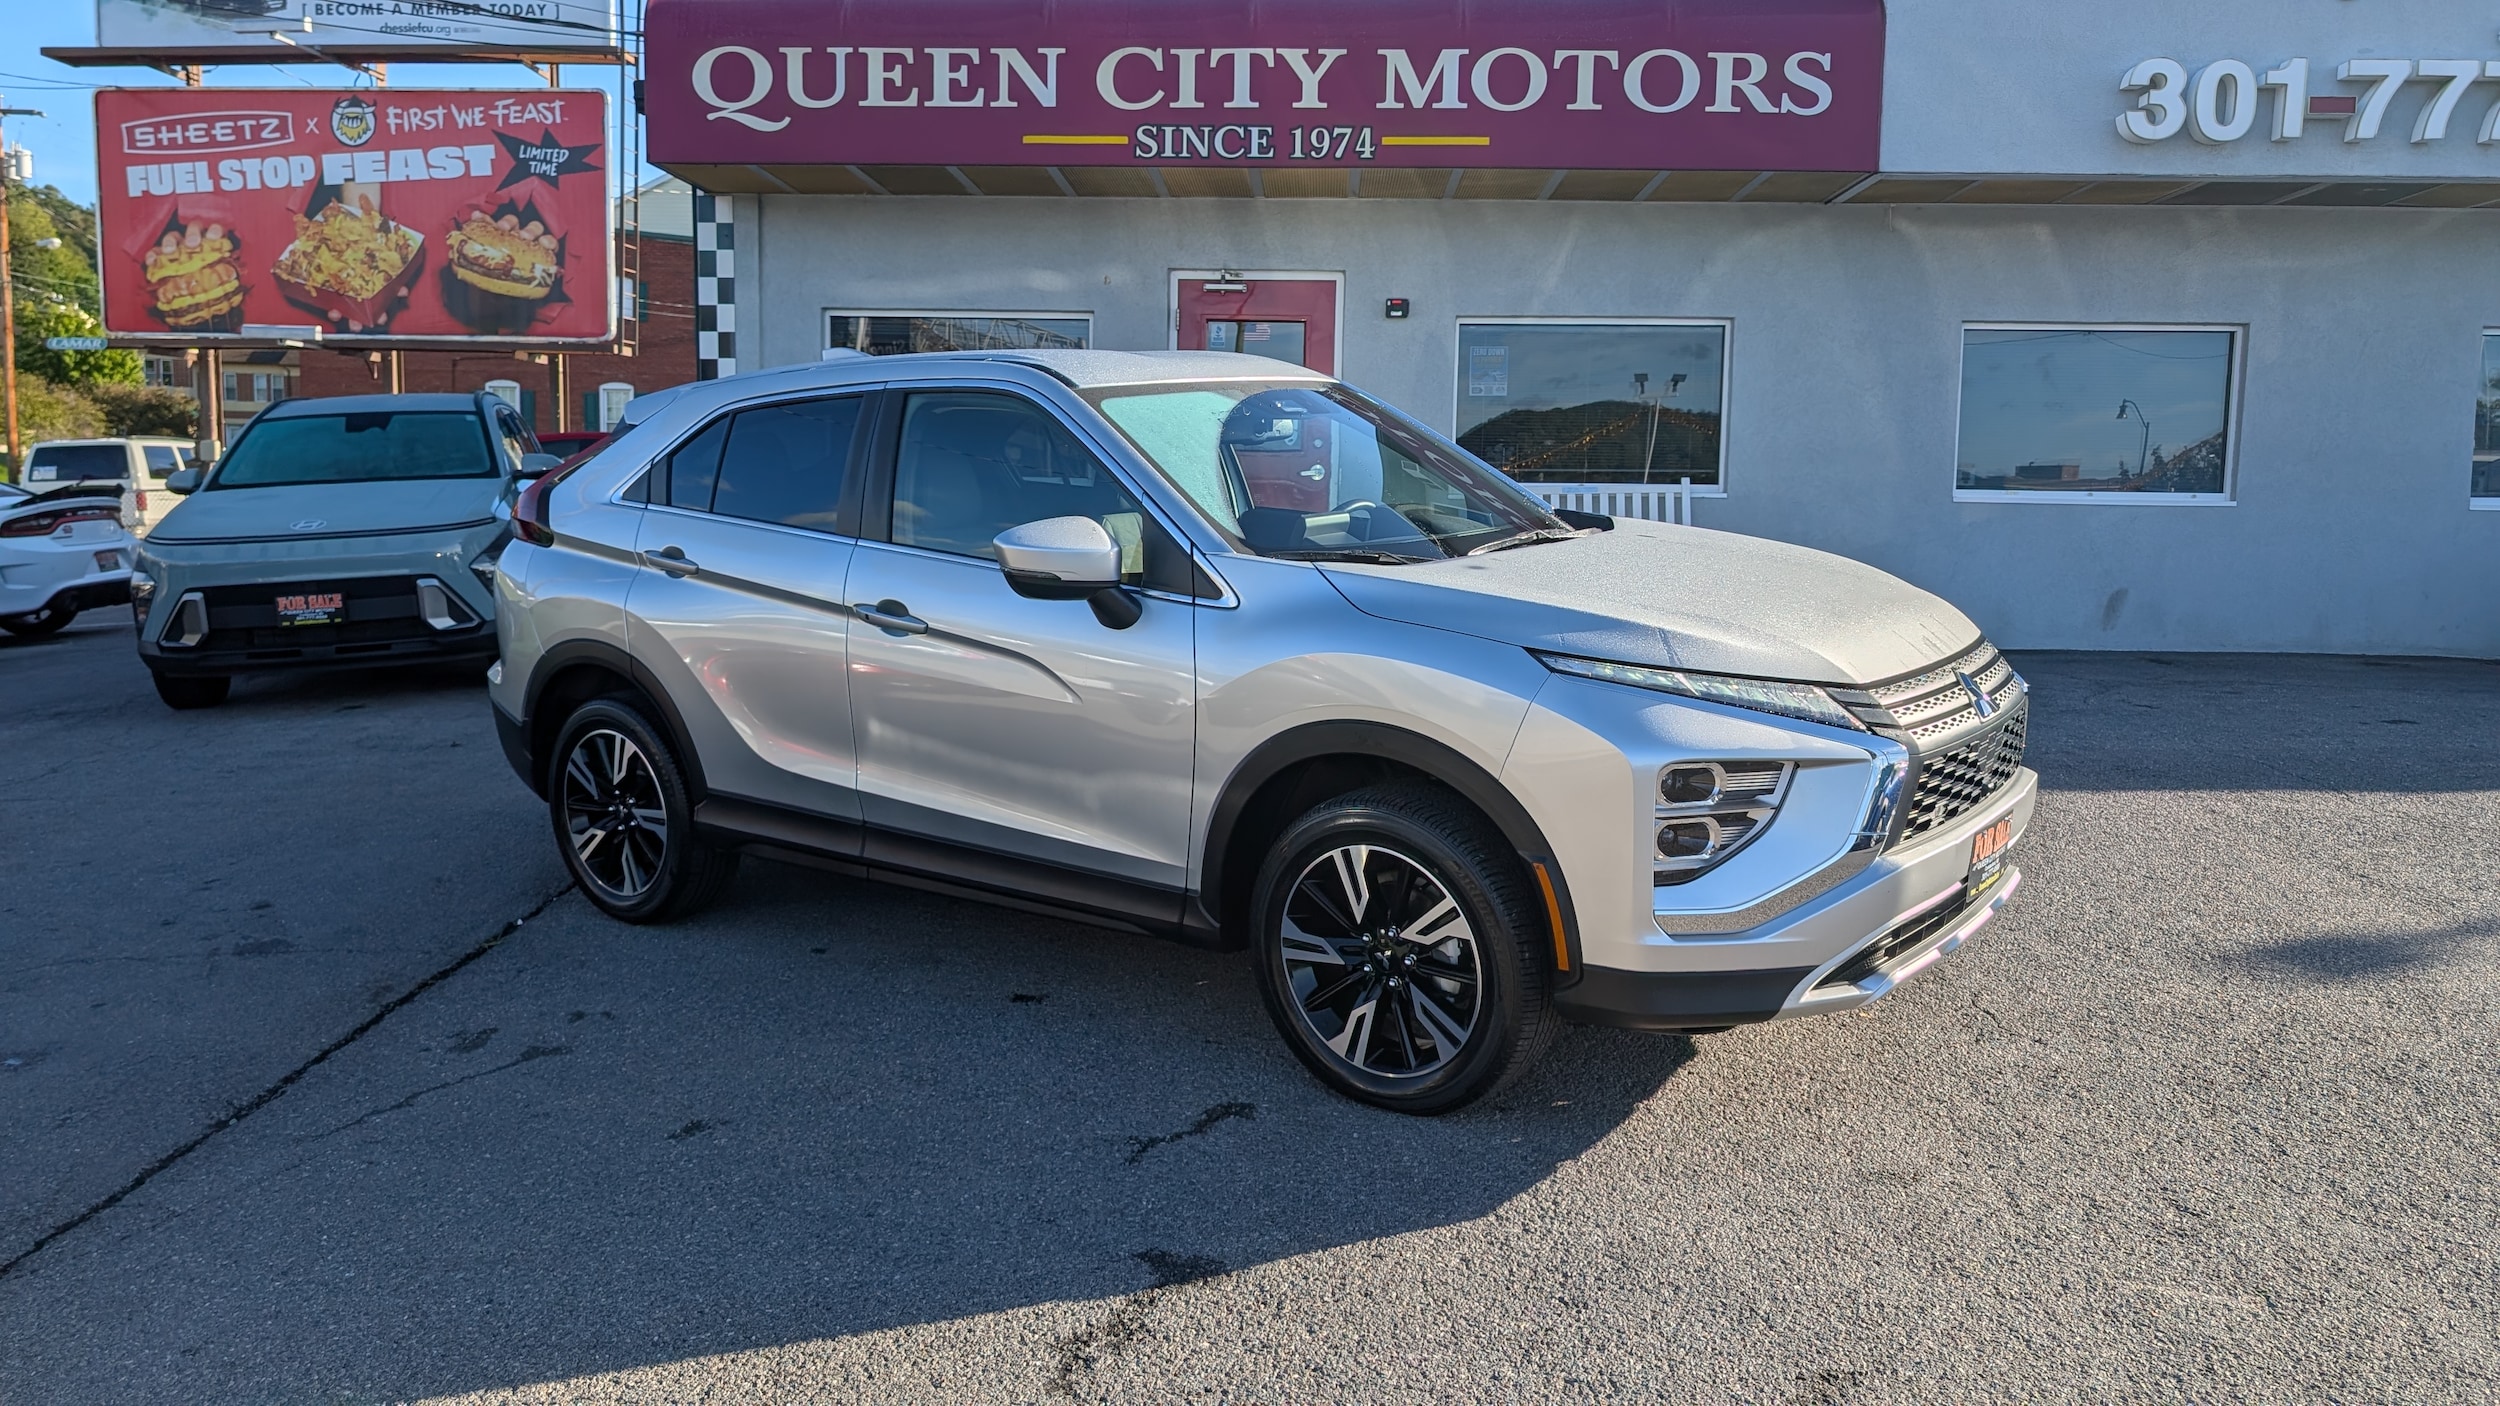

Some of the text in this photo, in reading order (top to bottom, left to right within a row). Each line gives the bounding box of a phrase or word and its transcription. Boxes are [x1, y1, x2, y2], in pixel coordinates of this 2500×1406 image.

[315, 3, 384, 15] BECOME
[392, 3, 403, 15] A
[489, 4, 547, 16] TODAY
[380, 22, 451, 36] chessiefcu.org
[692, 45, 1833, 132] QUEEN CITY MOTORS
[134, 118, 281, 147] SHEETZ
[386, 105, 447, 135] FIRST
[450, 103, 486, 129] WE
[519, 144, 569, 163] LIMITED
[1134, 124, 1376, 160] SINCE 1974
[126, 144, 496, 197] FUEL STOP FEAST
[528, 161, 558, 176] TIME
[277, 593, 342, 611] FOR SALE
[1973, 827, 1995, 864] FOR
